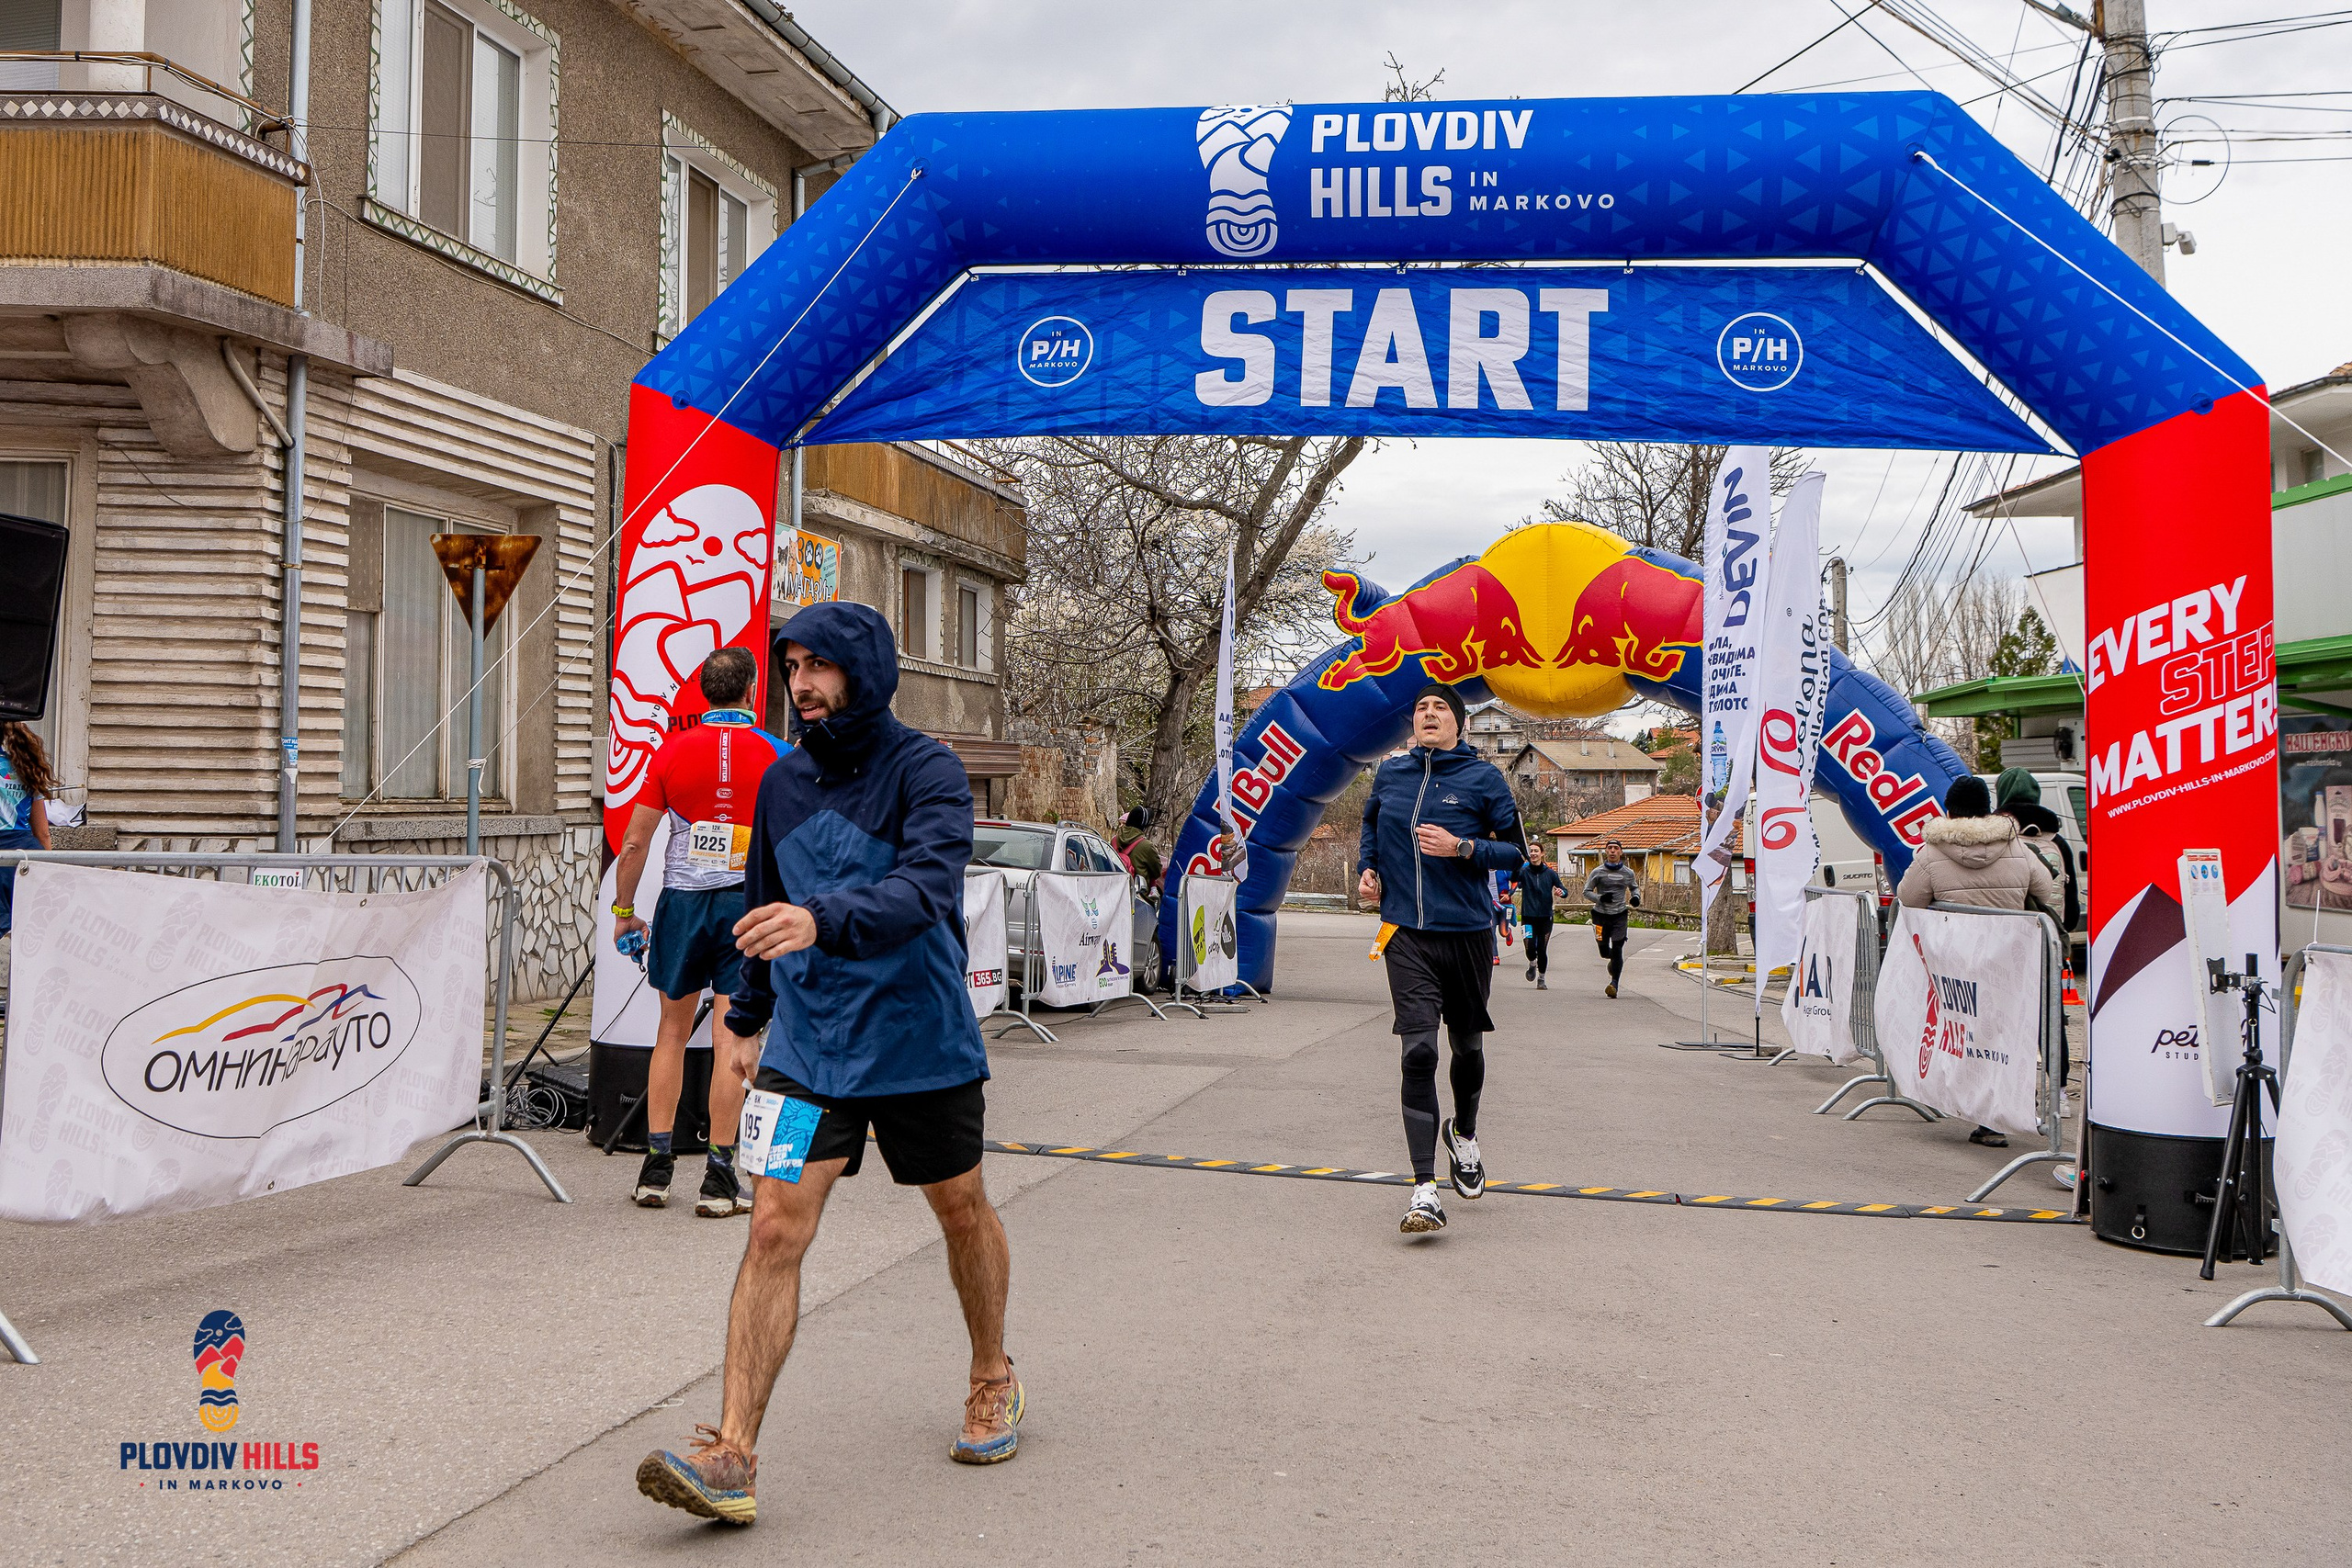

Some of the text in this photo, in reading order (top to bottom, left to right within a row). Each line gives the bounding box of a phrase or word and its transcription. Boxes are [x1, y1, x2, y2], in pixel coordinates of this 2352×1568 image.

[1311, 110, 1533, 153] PLOVDIV
[1310, 165, 1453, 218] HILLS
[1470, 193, 1615, 211] MARKOVO
[1471, 172, 1498, 187] IN
[1031, 339, 1081, 361] P/H
[1195, 288, 1609, 412] START
[1733, 337, 1788, 363] P/H
[1733, 364, 1787, 372] MARKOVO
[1723, 467, 1759, 627] DEVIN
[2088, 575, 2247, 695] EVERY
[2160, 620, 2274, 716] STEP
[1232, 722, 1304, 813] Bull
[1824, 713, 1923, 810] Red
[2108, 749, 2276, 818] WWW.PLOVDIV-HILLS-IN-MARKOVO.COM
[694, 835, 726, 852] 1225
[745, 1112, 763, 1140] 195
